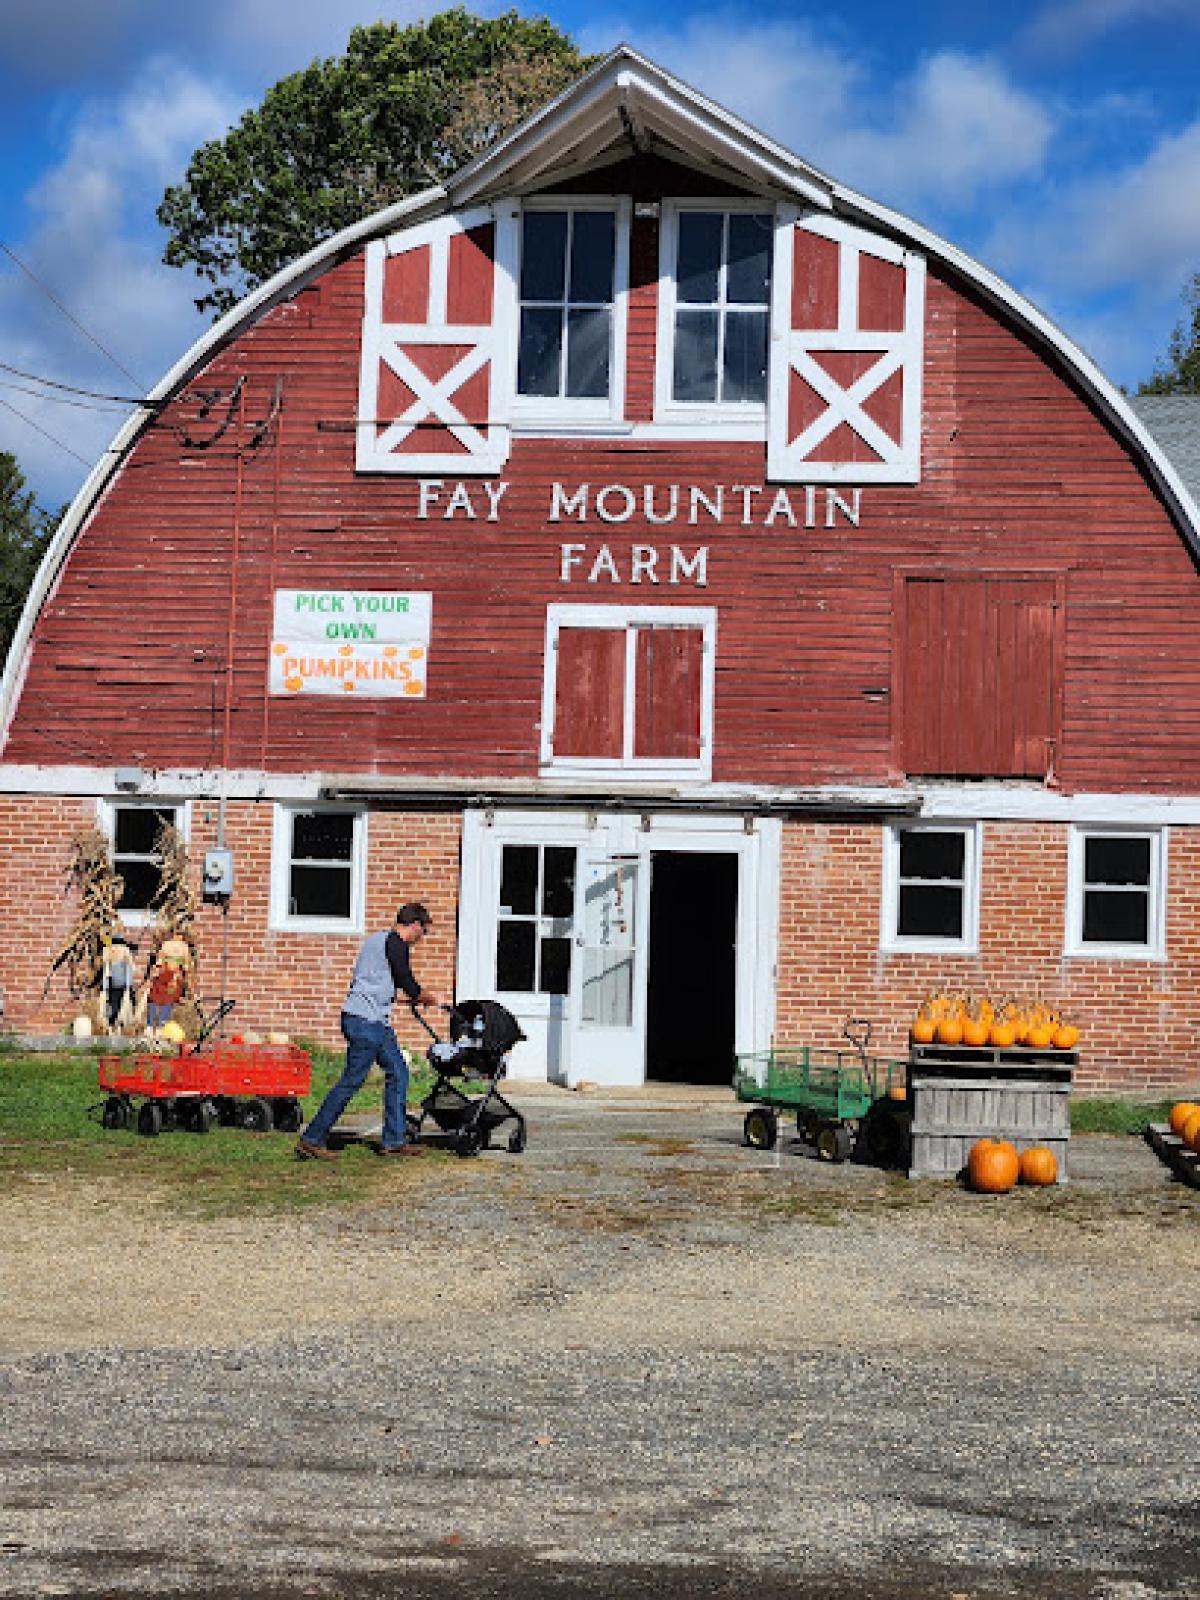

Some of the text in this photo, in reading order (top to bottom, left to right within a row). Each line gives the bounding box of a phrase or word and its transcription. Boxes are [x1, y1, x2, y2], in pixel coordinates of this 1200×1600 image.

[417, 479, 864, 528] FAY MOUNTAIN
[559, 543, 708, 586] FARM
[295, 593, 410, 613] PICK YOUR
[325, 622, 377, 640] OWN
[282, 655, 413, 682] PUMPKINS
